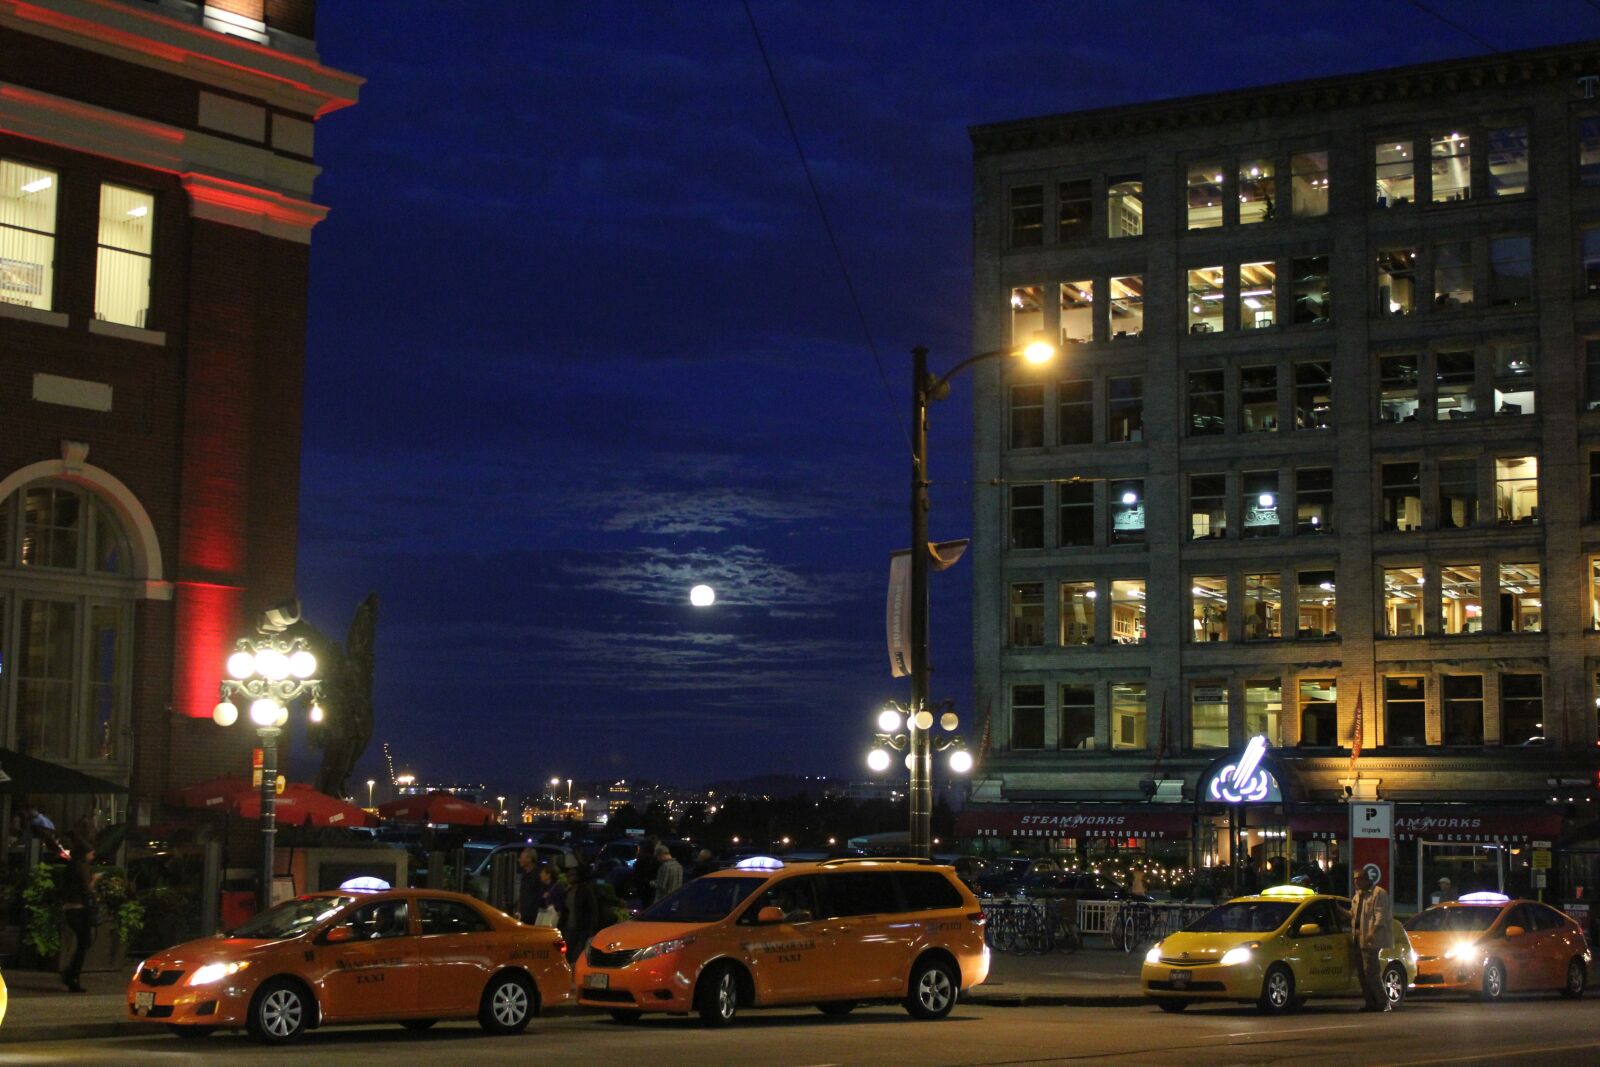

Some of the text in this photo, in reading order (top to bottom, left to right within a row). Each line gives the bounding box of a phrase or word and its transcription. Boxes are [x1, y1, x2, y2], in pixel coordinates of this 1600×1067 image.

[1021, 815, 1126, 825] STEAMWORKS
[1012, 829, 1066, 837] BREWERY
[1085, 830, 1165, 838] RESTAURANT
[1312, 832, 1336, 840] PUB
[1438, 833, 1529, 842] RESTAURANT
[356, 973, 384, 984] TAXI
